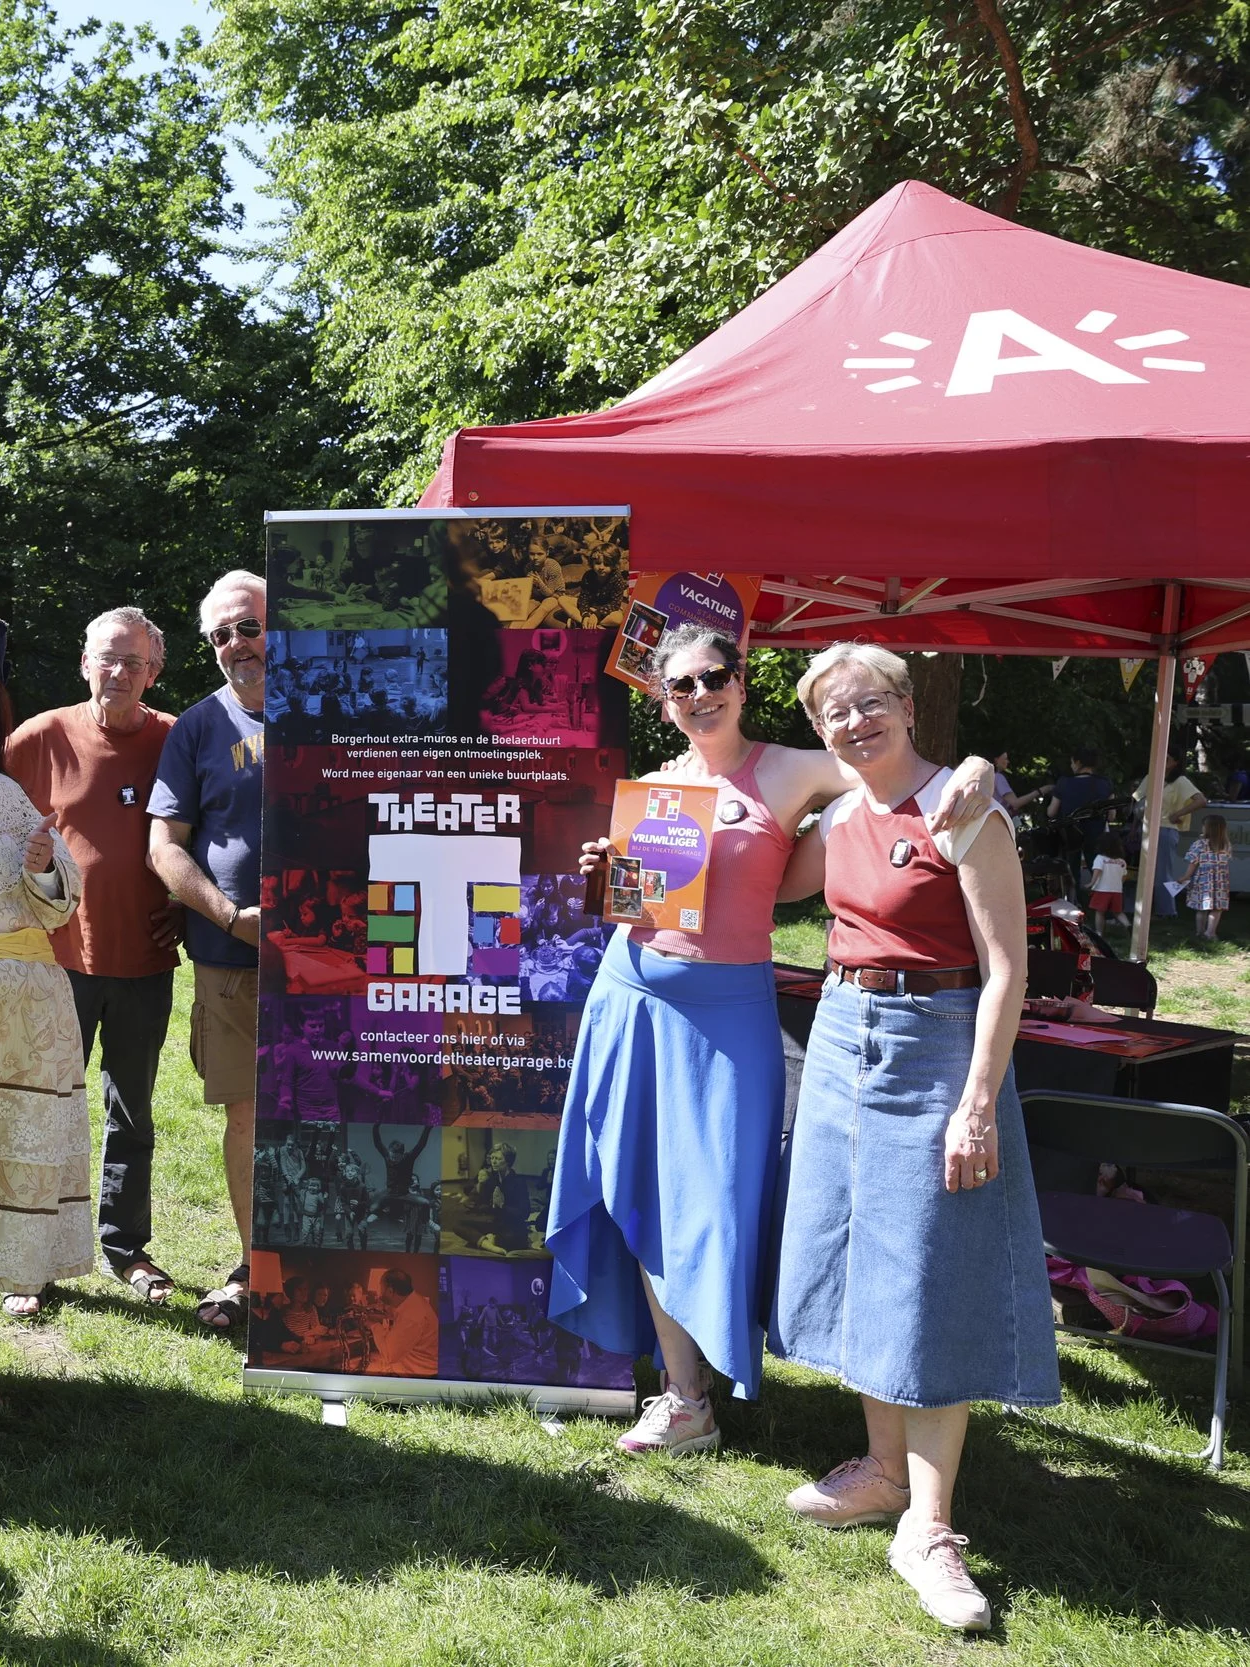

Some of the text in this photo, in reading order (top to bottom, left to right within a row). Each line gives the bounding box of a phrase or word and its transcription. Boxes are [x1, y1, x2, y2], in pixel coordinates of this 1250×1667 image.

[944, 308, 1150, 397] A
[680, 584, 738, 620] VACATURE
[331, 733, 561, 746] Borgerhout extra-muros en de Boelaerbuurt
[346, 748, 545, 761] verdienen een eigen ontmoetingsplek.
[321, 768, 570, 782] Word mee eigenaar van een unieke buurtplaats.
[368, 792, 521, 832] THEATER
[631, 832, 699, 848] VRIJWILLIGER
[667, 826, 700, 838] WORD
[367, 982, 522, 1015] GARAGE
[360, 1030, 526, 1047] contacteer ons hier of via
[311, 1050, 574, 1072] www.samenvoordetheatergarage.be
